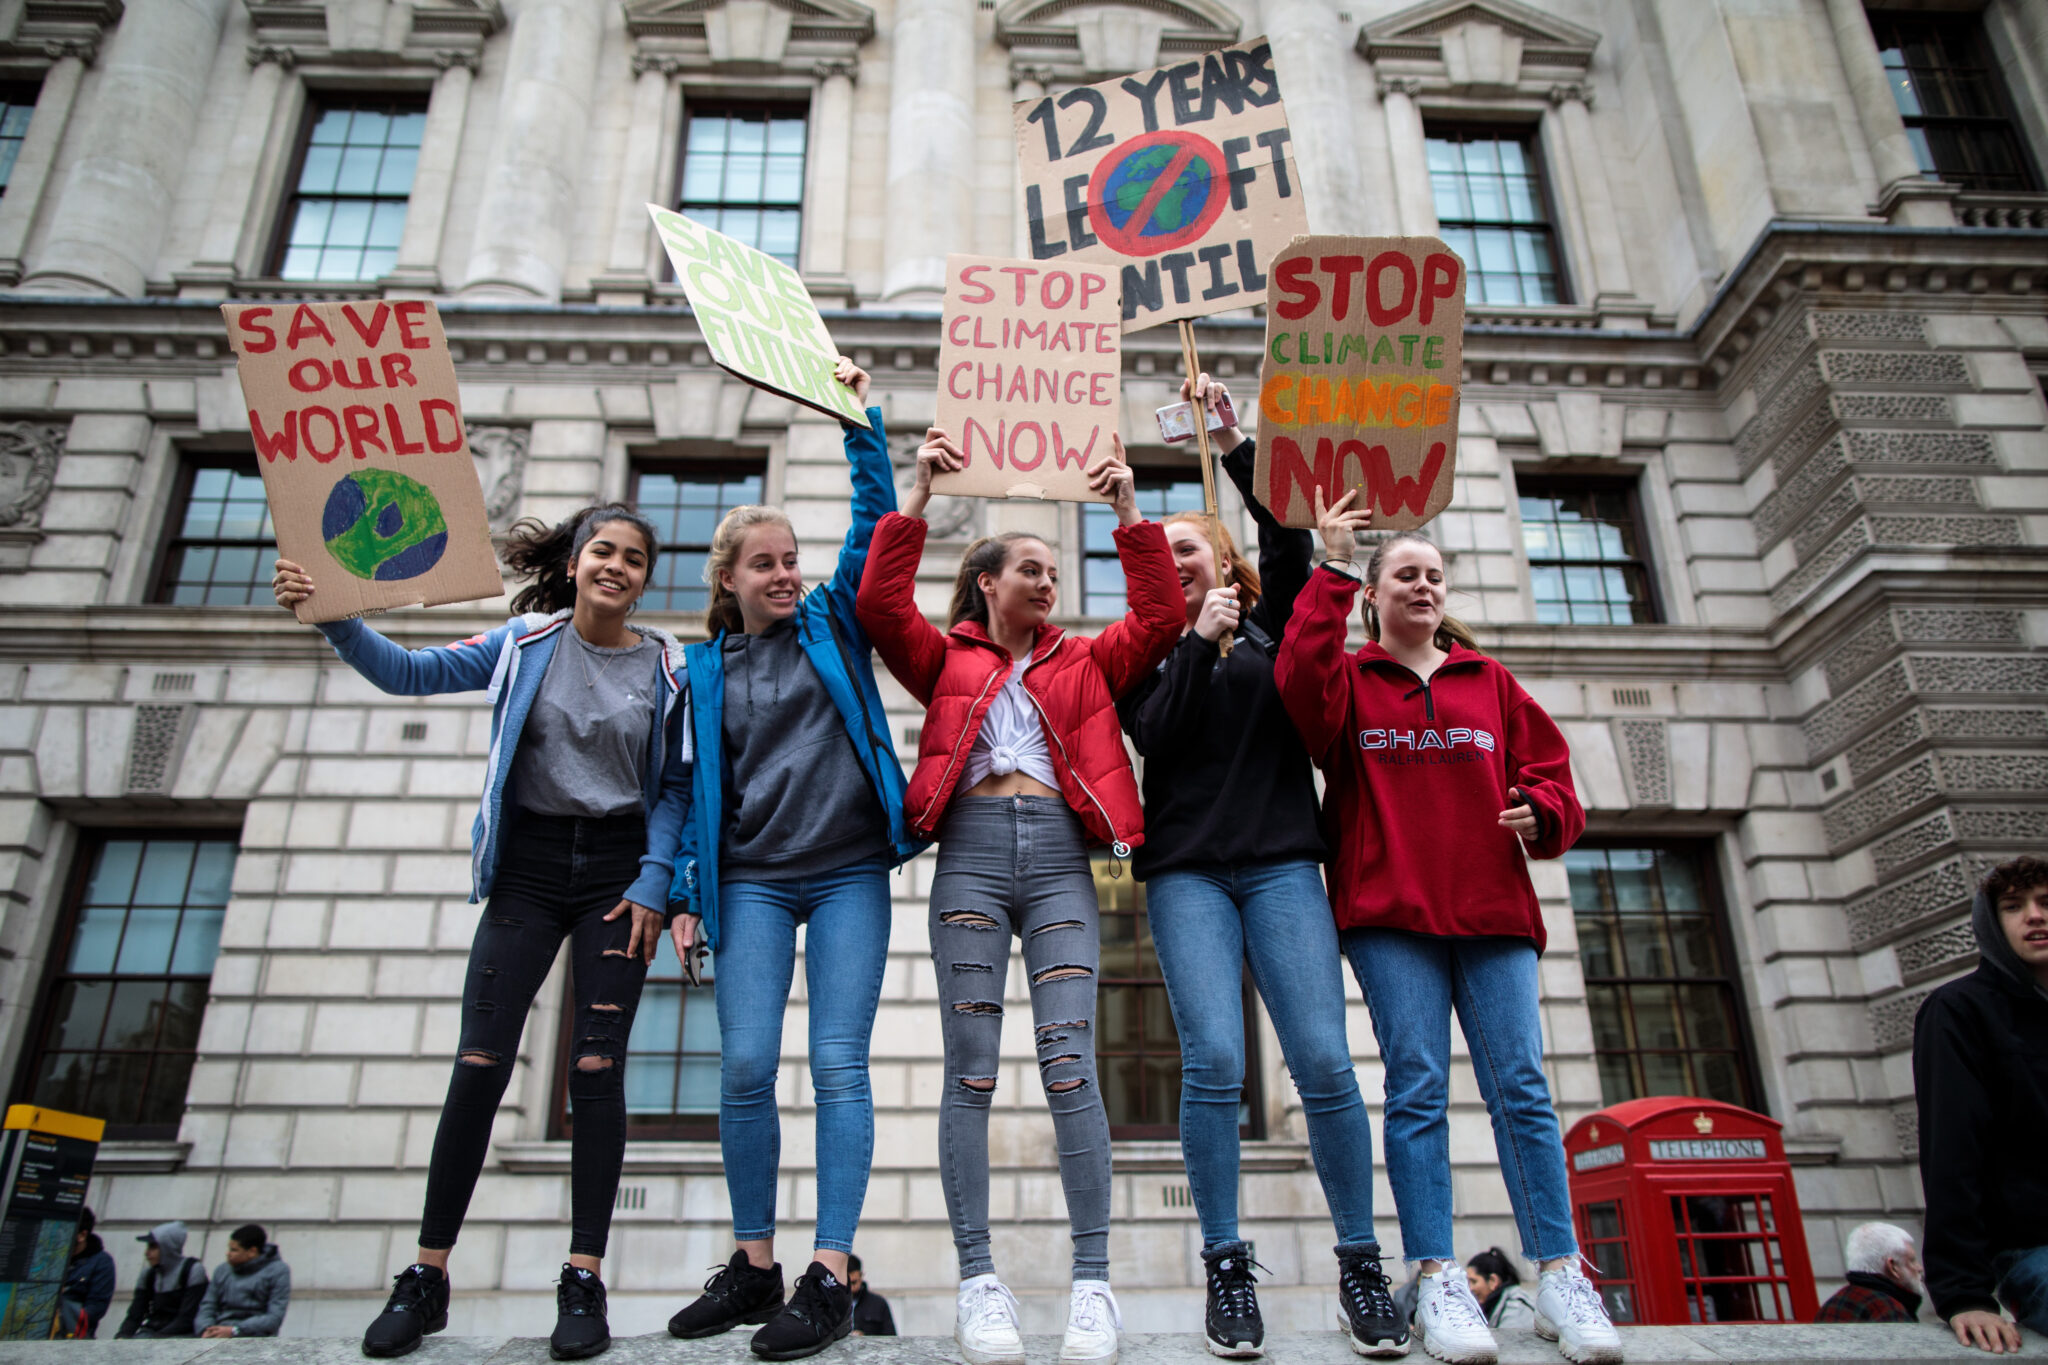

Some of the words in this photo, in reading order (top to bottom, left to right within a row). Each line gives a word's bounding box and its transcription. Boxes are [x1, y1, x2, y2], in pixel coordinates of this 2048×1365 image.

[1026, 87, 1115, 161] 12
[1121, 43, 1281, 133] YEARS
[655, 211, 815, 312] SAVE
[959, 265, 1106, 310] STOP
[1122, 239, 1266, 321] NTIL
[687, 262, 827, 353] OUR
[1275, 251, 1459, 327] STOP
[238, 302, 431, 354] SAVE
[949, 315, 1118, 353] CLIMATE
[1271, 332, 1445, 369] CLIMATE
[288, 353, 417, 392] OUR
[948, 361, 1114, 405] CHANGE
[1259, 375, 1454, 428] CHANGE
[249, 398, 464, 463] WORLD
[962, 417, 1099, 472] NOW
[1269, 436, 1446, 523] NOW
[1359, 728, 1495, 752] CHAPS
[1378, 753, 1424, 765] RALPH
[1429, 752, 1485, 765] LAUREN
[1650, 1139, 1762, 1159] TELEPHONE
